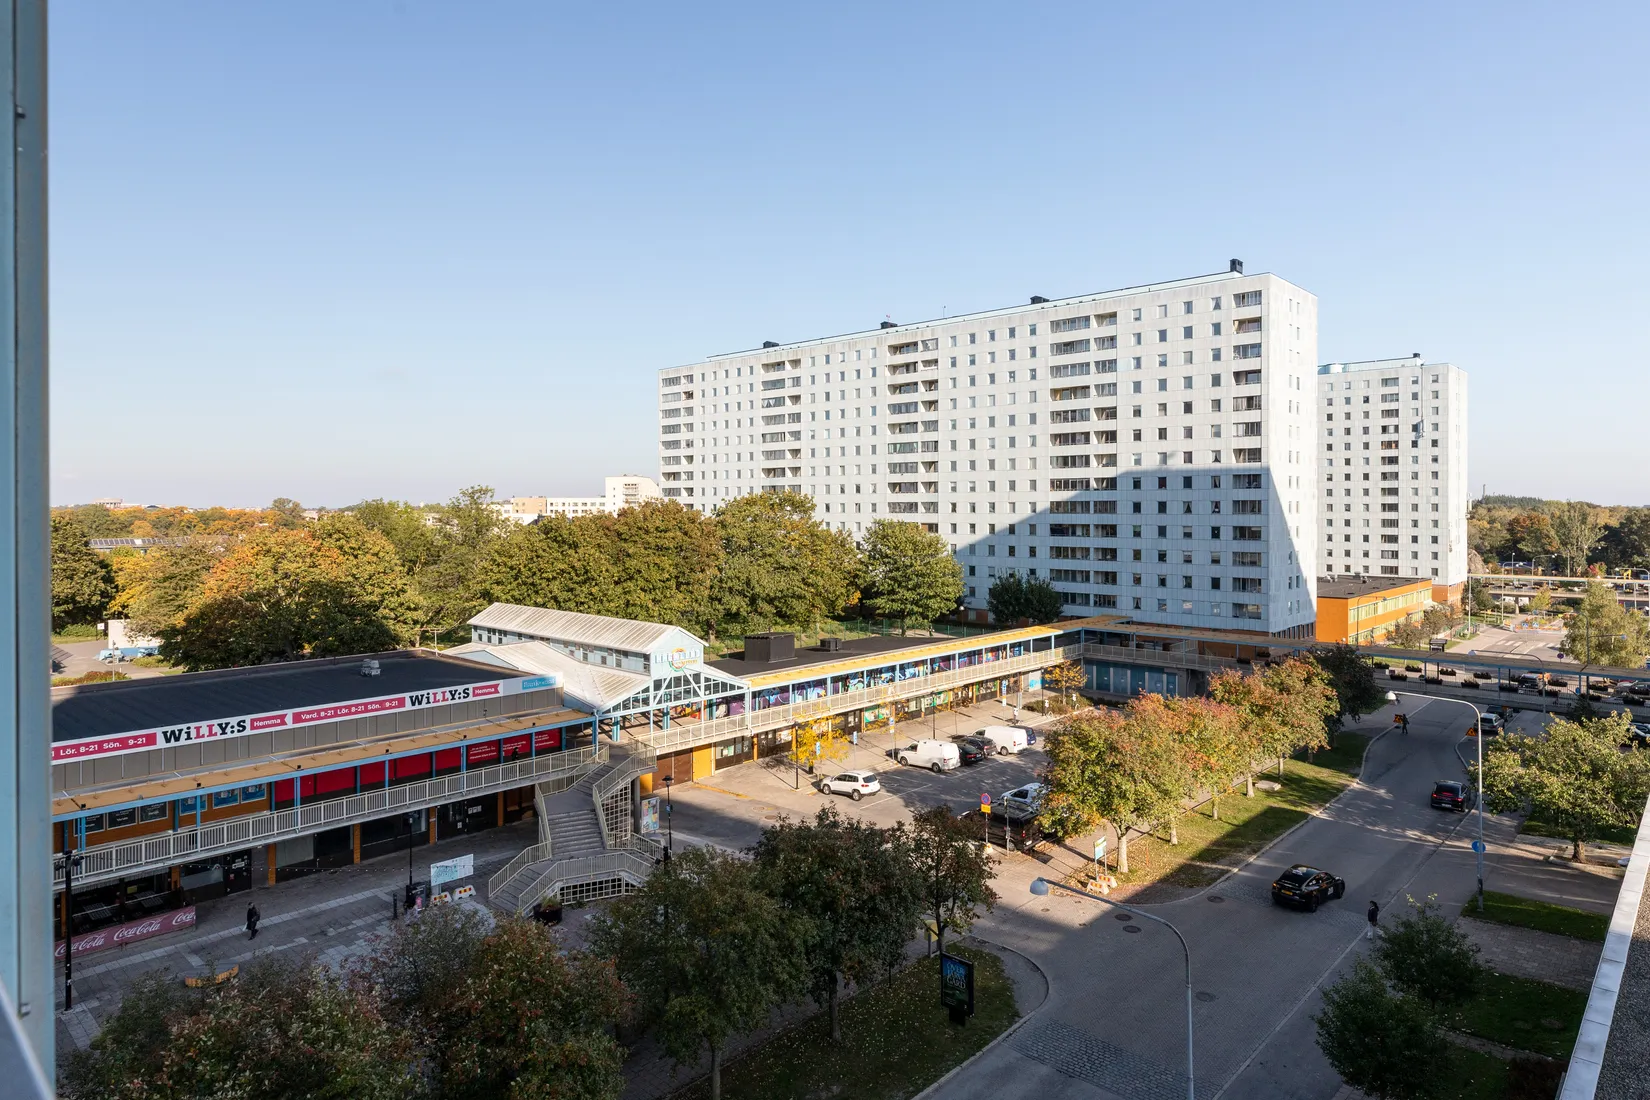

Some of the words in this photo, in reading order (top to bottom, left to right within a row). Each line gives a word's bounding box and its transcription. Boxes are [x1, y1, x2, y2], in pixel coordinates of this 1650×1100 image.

[475, 687, 495, 695] Hemma
[301, 712, 319, 720] Vard.
[337, 706, 350, 714] Lör.
[367, 702, 381, 711] Sön.
[385, 700, 398, 708] 9-21
[253, 717, 281, 727] Hemma
[60, 746, 78, 756] Lör.
[80, 744, 98, 753] 8-21
[102, 740, 122, 750] Sön.
[128, 737, 146, 747] 9-21
